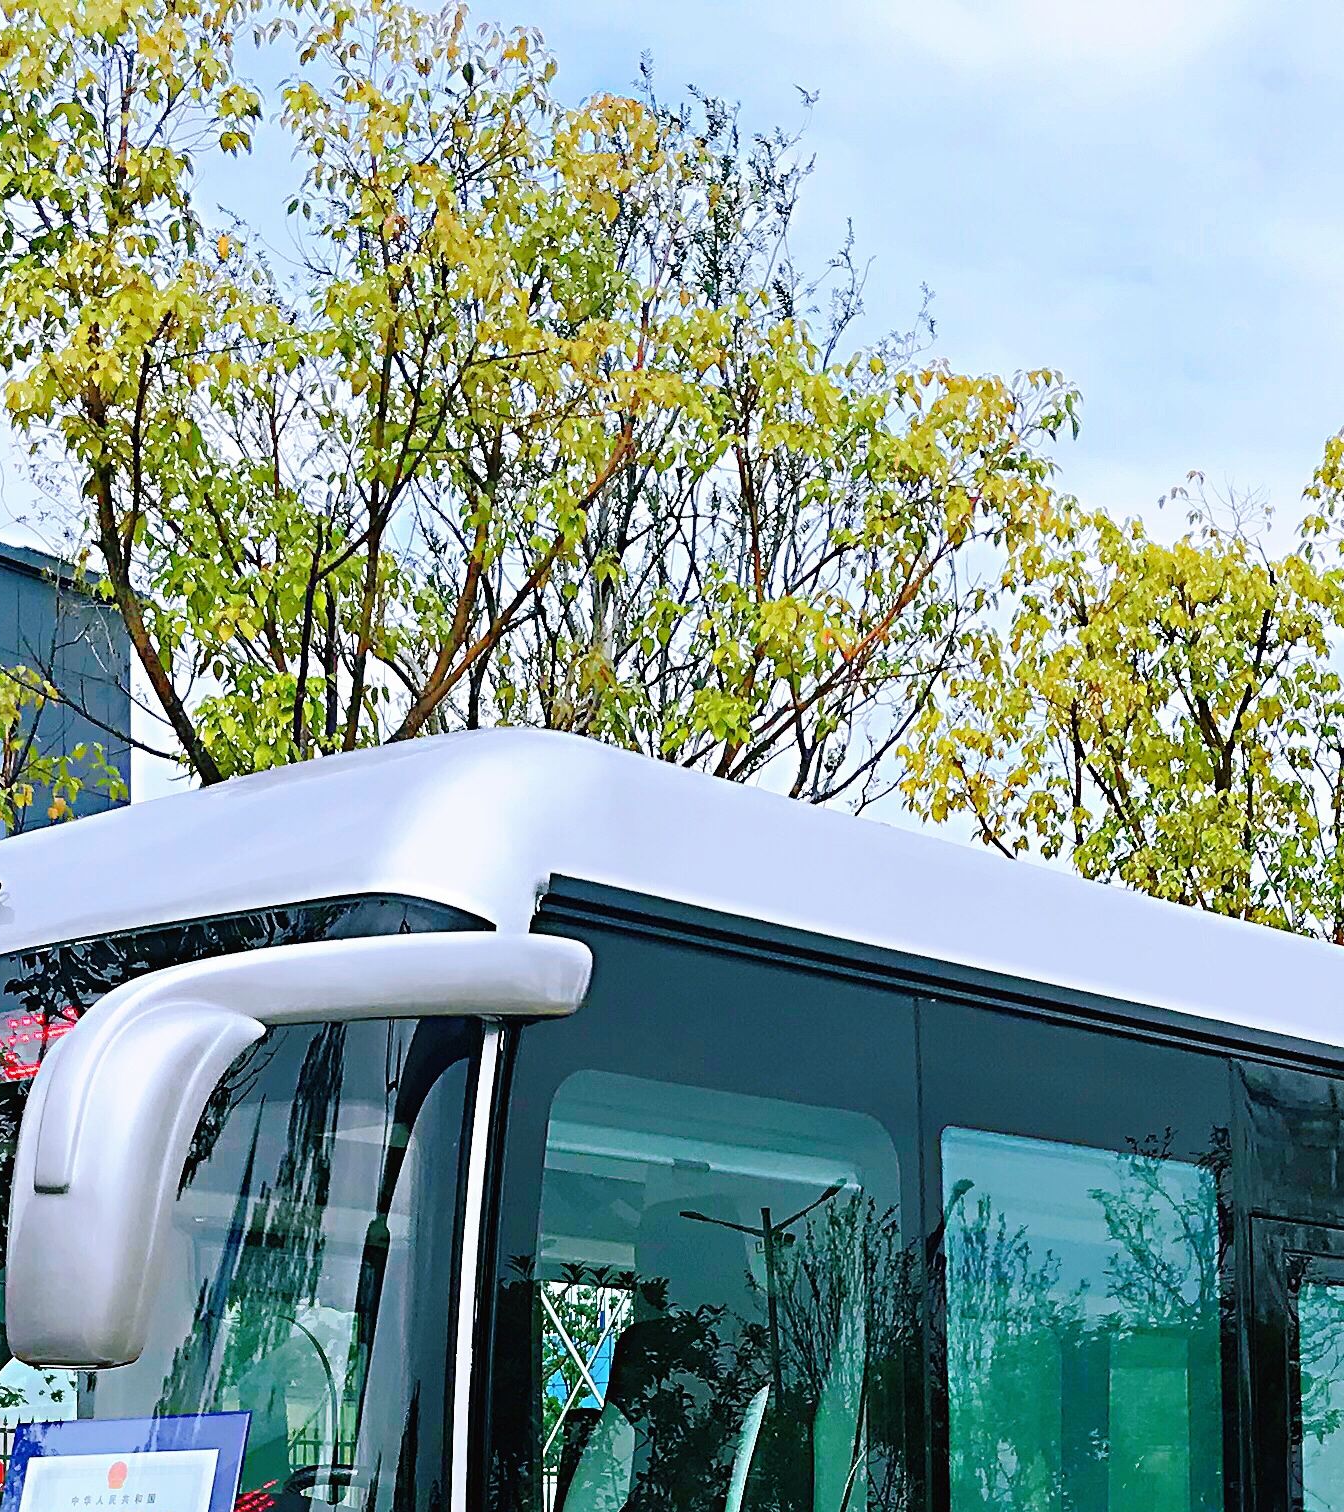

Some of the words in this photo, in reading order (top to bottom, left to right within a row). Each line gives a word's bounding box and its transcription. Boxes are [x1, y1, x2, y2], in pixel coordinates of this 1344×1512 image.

[71, 1493, 157, 1507] 中华人民共和国
